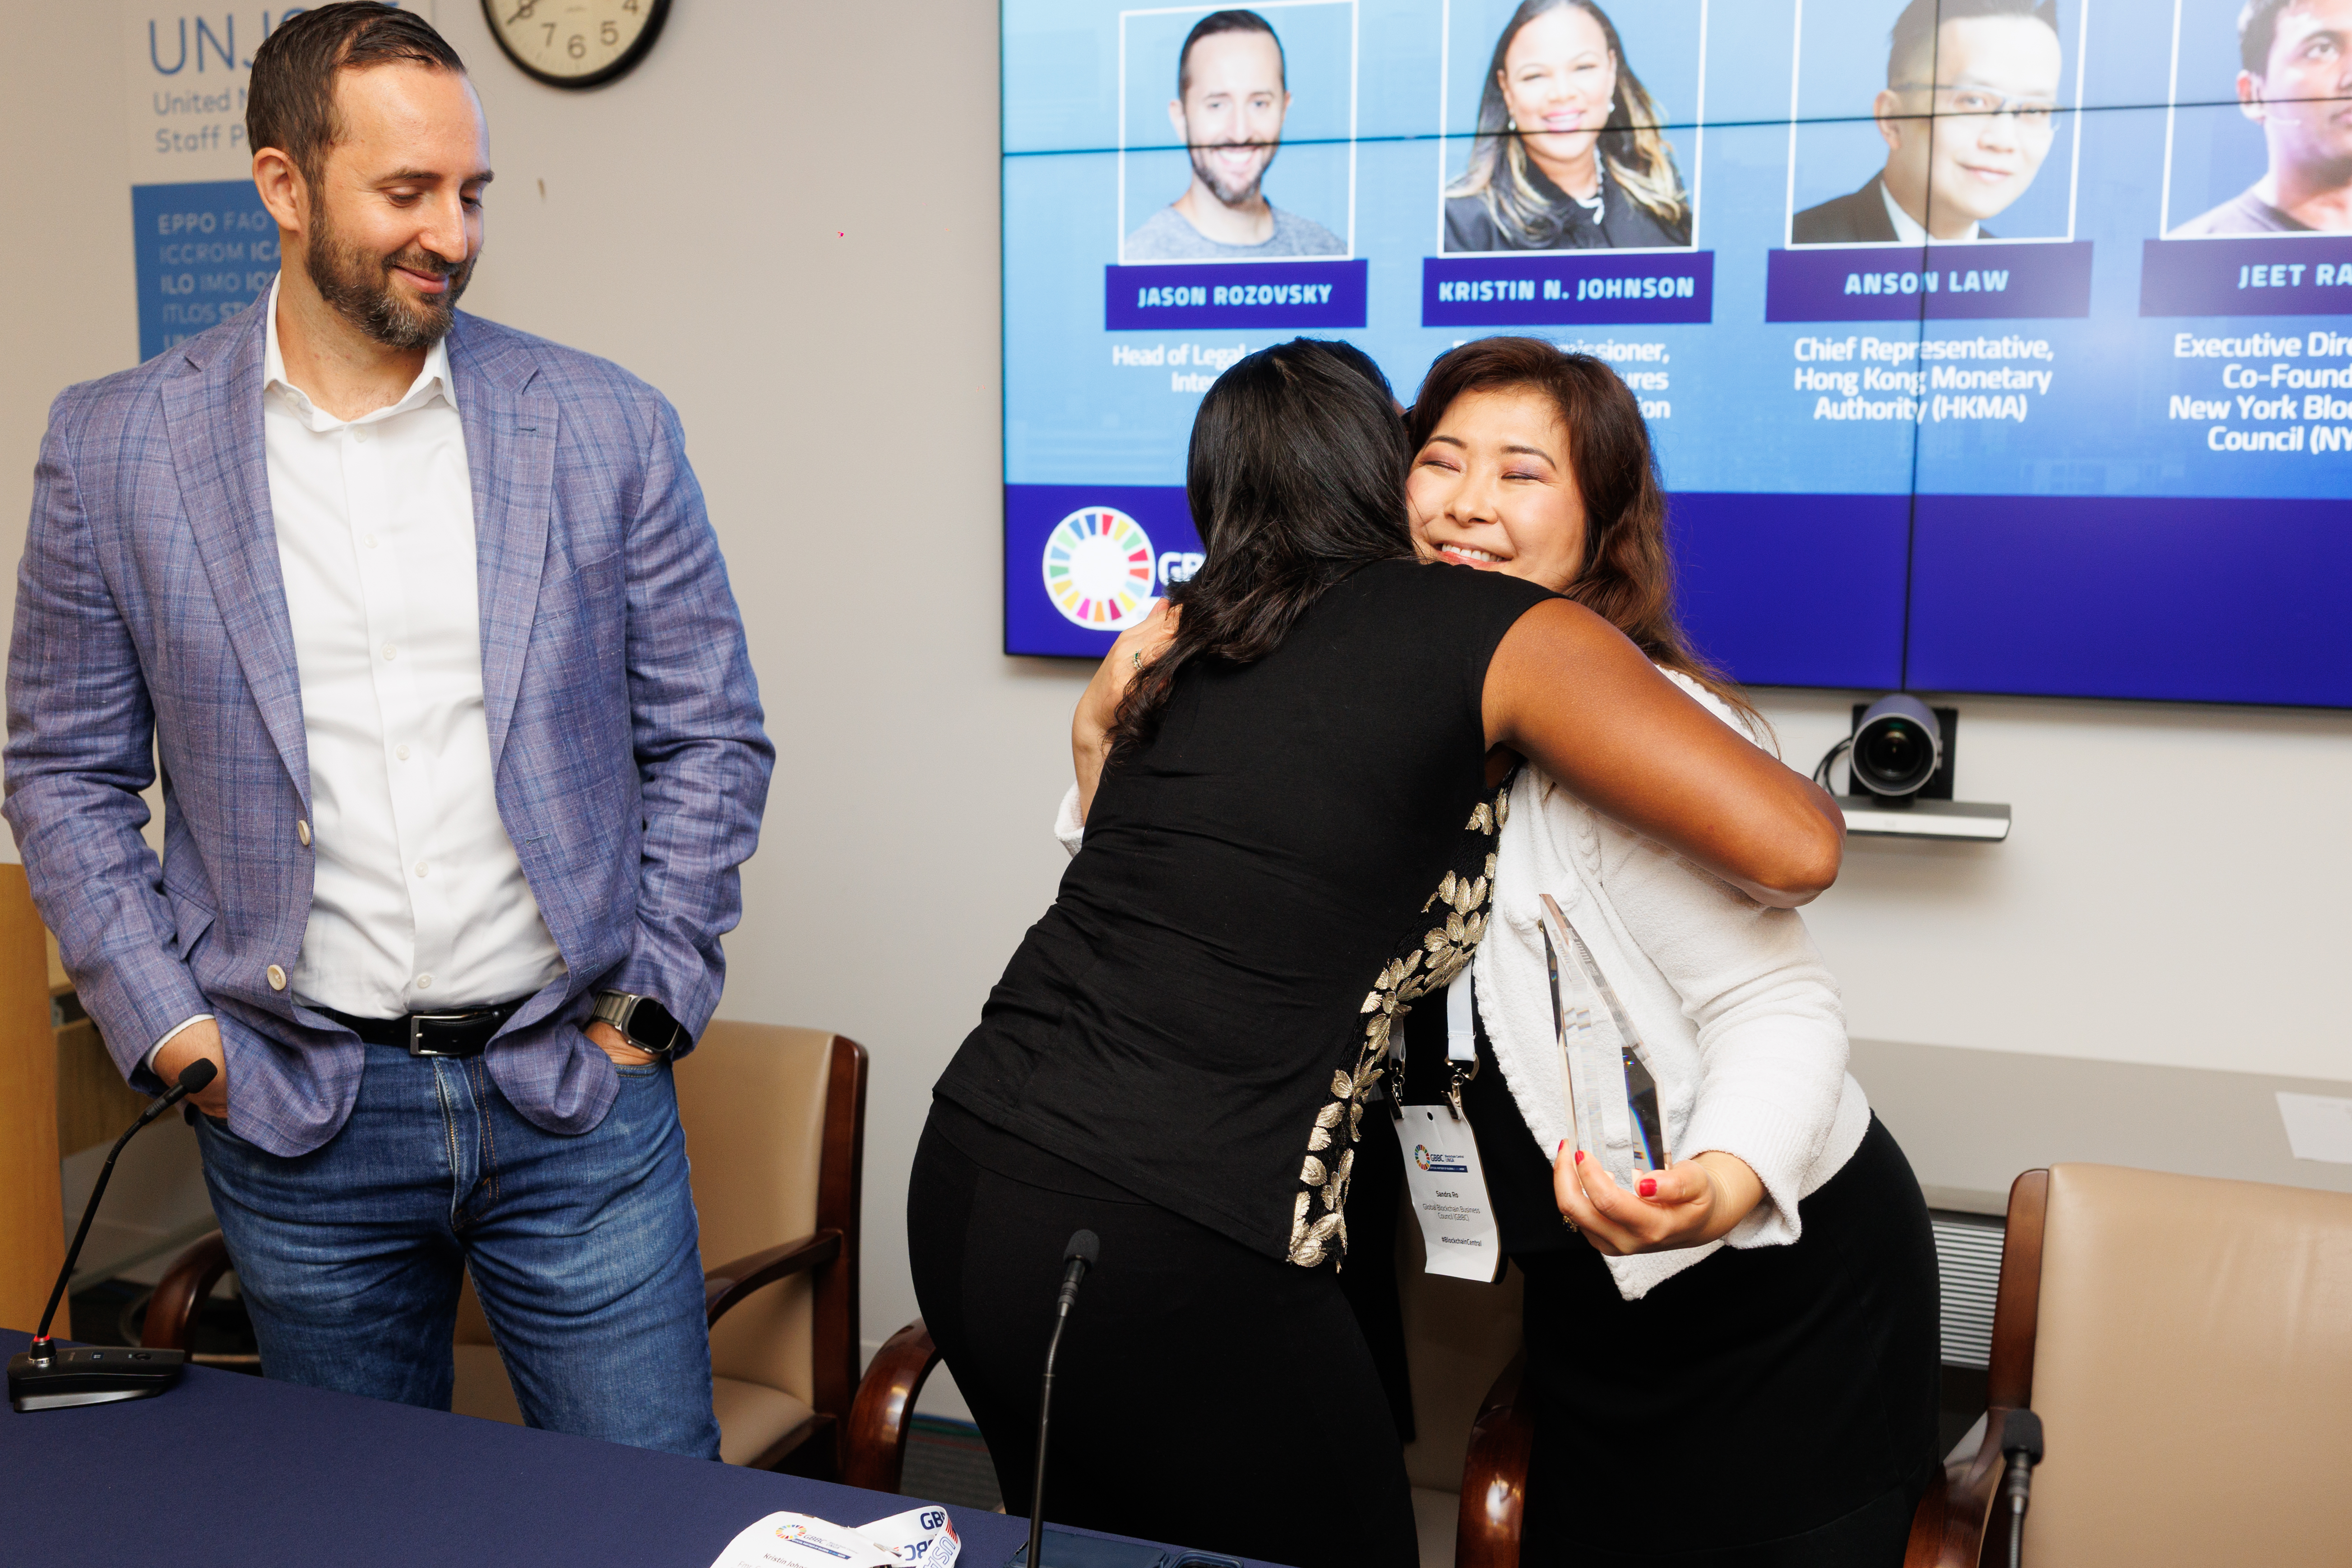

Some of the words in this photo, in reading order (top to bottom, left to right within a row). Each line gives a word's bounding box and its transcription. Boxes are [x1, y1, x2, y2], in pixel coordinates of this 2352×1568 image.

[542, 23, 557, 48] 7
[600, 21, 619, 46] 5
[567, 34, 586, 59] 6
[153, 90, 231, 116] United
[156, 125, 220, 153] Staff
[158, 212, 217, 236] EPPO
[223, 210, 269, 233] FAO
[161, 273, 195, 295] ILO
[1439, 280, 1535, 301] KRISTIN
[1544, 280, 1570, 300] N.
[1577, 277, 1694, 301] JOHNSON
[1845, 272, 1939, 294] ANSON
[1949, 270, 2009, 292] LAW
[2238, 264, 2306, 289] JEET
[2316, 264, 2352, 286] RA
[1138, 287, 1206, 308] JASON
[1213, 284, 1332, 305] ROZOVSKY
[1112, 344, 1165, 366] Head
[1167, 343, 1190, 365] of
[1192, 343, 1246, 371] Legal
[1794, 336, 1857, 361] Chief
[1861, 335, 2054, 366] Representative,
[2174, 332, 2302, 357] Executive
[1794, 366, 1859, 397] Hong
[1863, 366, 1927, 396] Kong
[1931, 365, 2053, 395] Monetary
[2222, 363, 2352, 389] Co-Found
[1813, 395, 1928, 424] Authority
[1932, 394, 2028, 423] (HKMA)
[2169, 395, 2232, 420] New
[2236, 394, 2297, 420] York
[2208, 426, 2305, 451] Council
[2310, 424, 2352, 455] (NY
[1430, 1154, 1444, 1162] GBBC
[1436, 1204, 1460, 1212] Blockchain
[1459, 1206, 1480, 1214] Business
[1441, 1236, 1482, 1247] #BlockchainCentral
[803, 1534, 827, 1545] GBBC
[763, 1553, 787, 1564] Kristin
